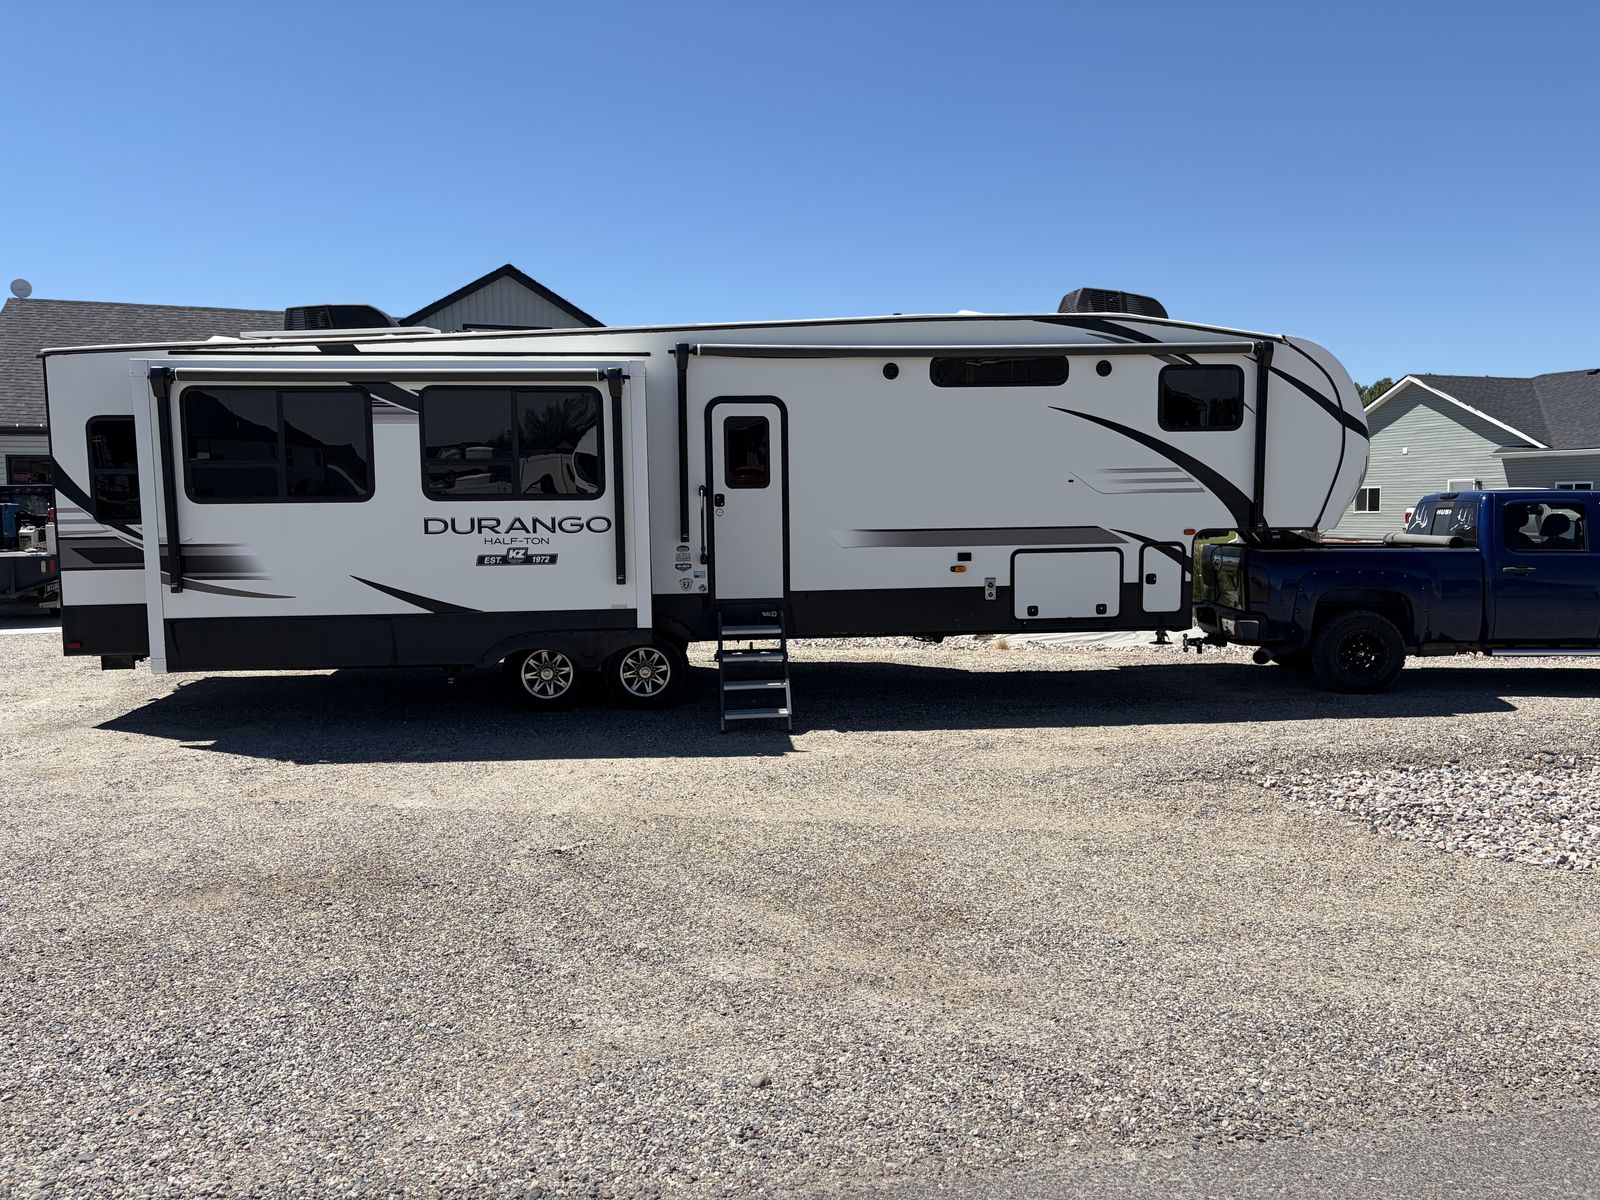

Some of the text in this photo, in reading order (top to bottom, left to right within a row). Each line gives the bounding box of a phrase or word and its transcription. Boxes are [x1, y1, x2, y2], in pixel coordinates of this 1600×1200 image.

[424, 516, 612, 535] DURANGO
[484, 537, 550, 545] HALF-TON
[508, 549, 526, 558] KZ
[484, 556, 502, 564] EST.
